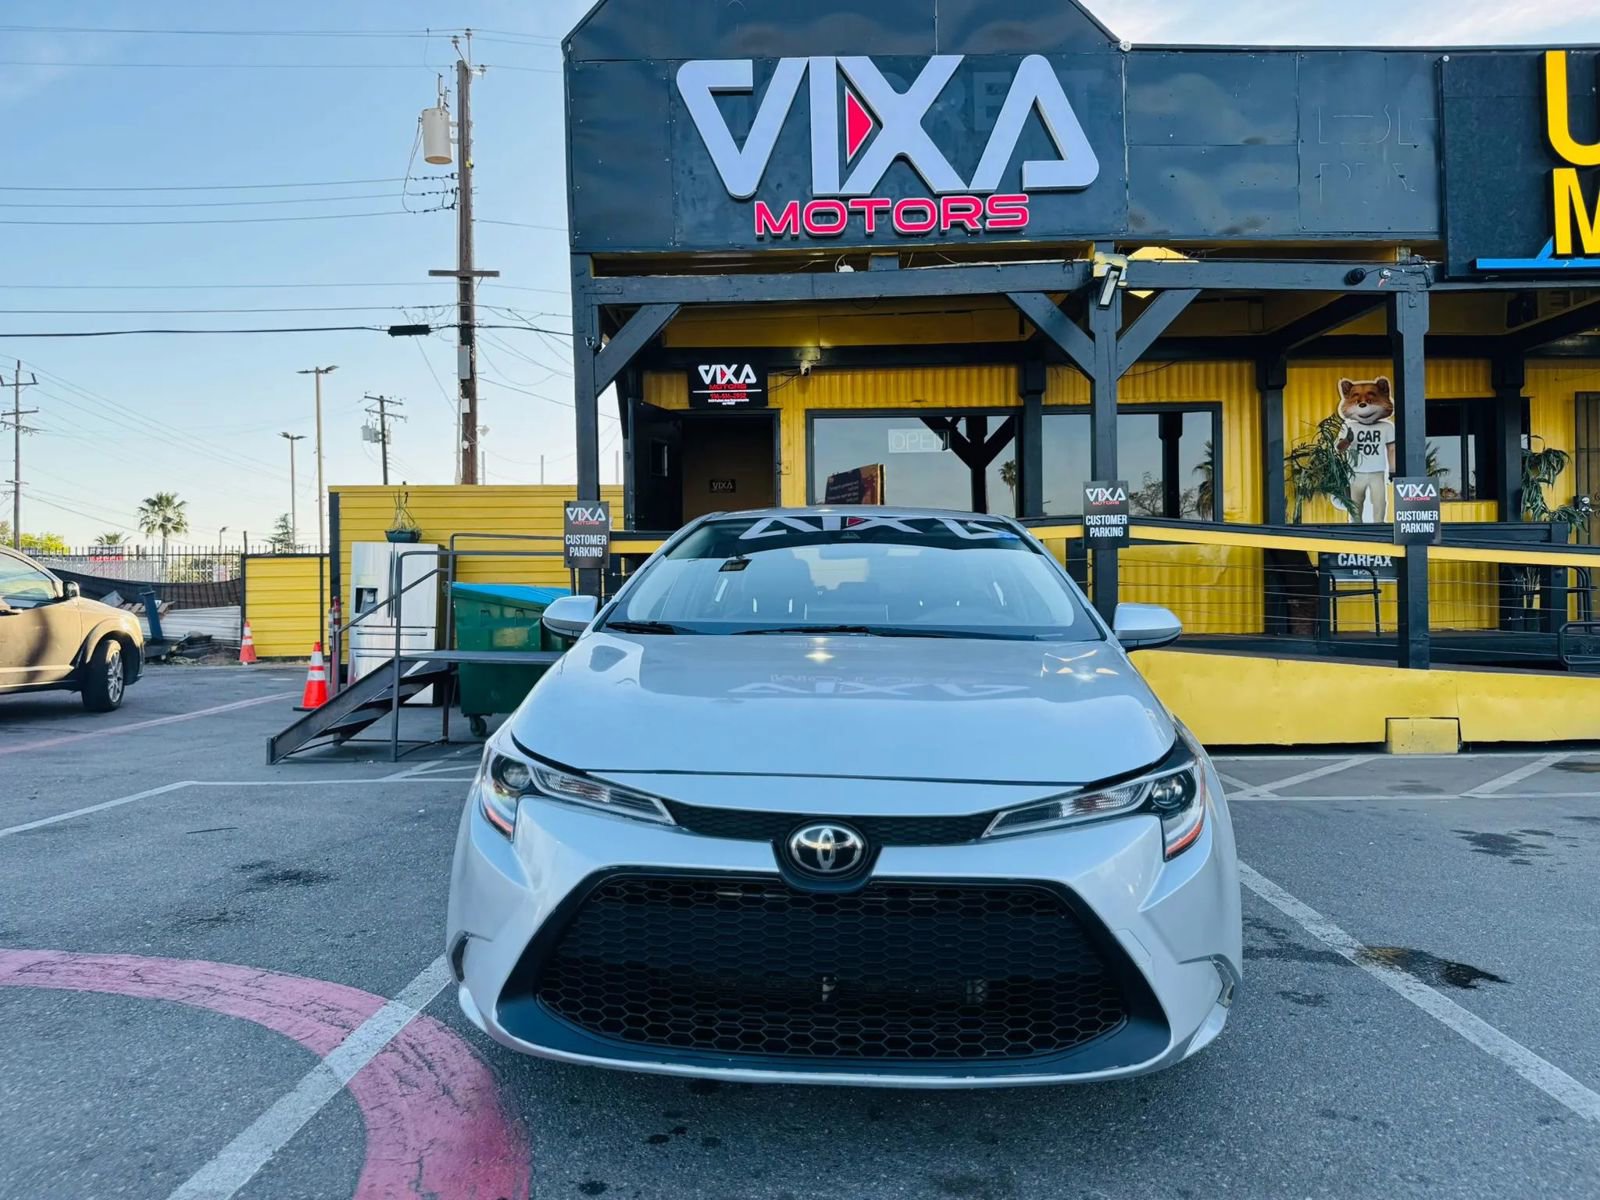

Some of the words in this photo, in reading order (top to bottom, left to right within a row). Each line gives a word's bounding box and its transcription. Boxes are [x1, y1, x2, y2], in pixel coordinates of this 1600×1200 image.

[675, 54, 1100, 199] VIXA
[754, 194, 1030, 237] MOTORS
[698, 364, 757, 384] VIXA
[1357, 430, 1381, 442] CAR
[1357, 443, 1380, 455] FOX
[1085, 487, 1126, 501] VIXA
[1396, 484, 1437, 497] VIXA
[564, 507, 606, 521] VIXA
[1085, 515, 1127, 525] CUSTOMER
[1396, 510, 1438, 521] CUSTOMER
[1090, 527, 1124, 537] PARKING
[1401, 522, 1434, 533] PARKING
[565, 535, 607, 545] CUSTOMER
[569, 546, 603, 557] PARKING
[1337, 553, 1392, 566] CARFAX
